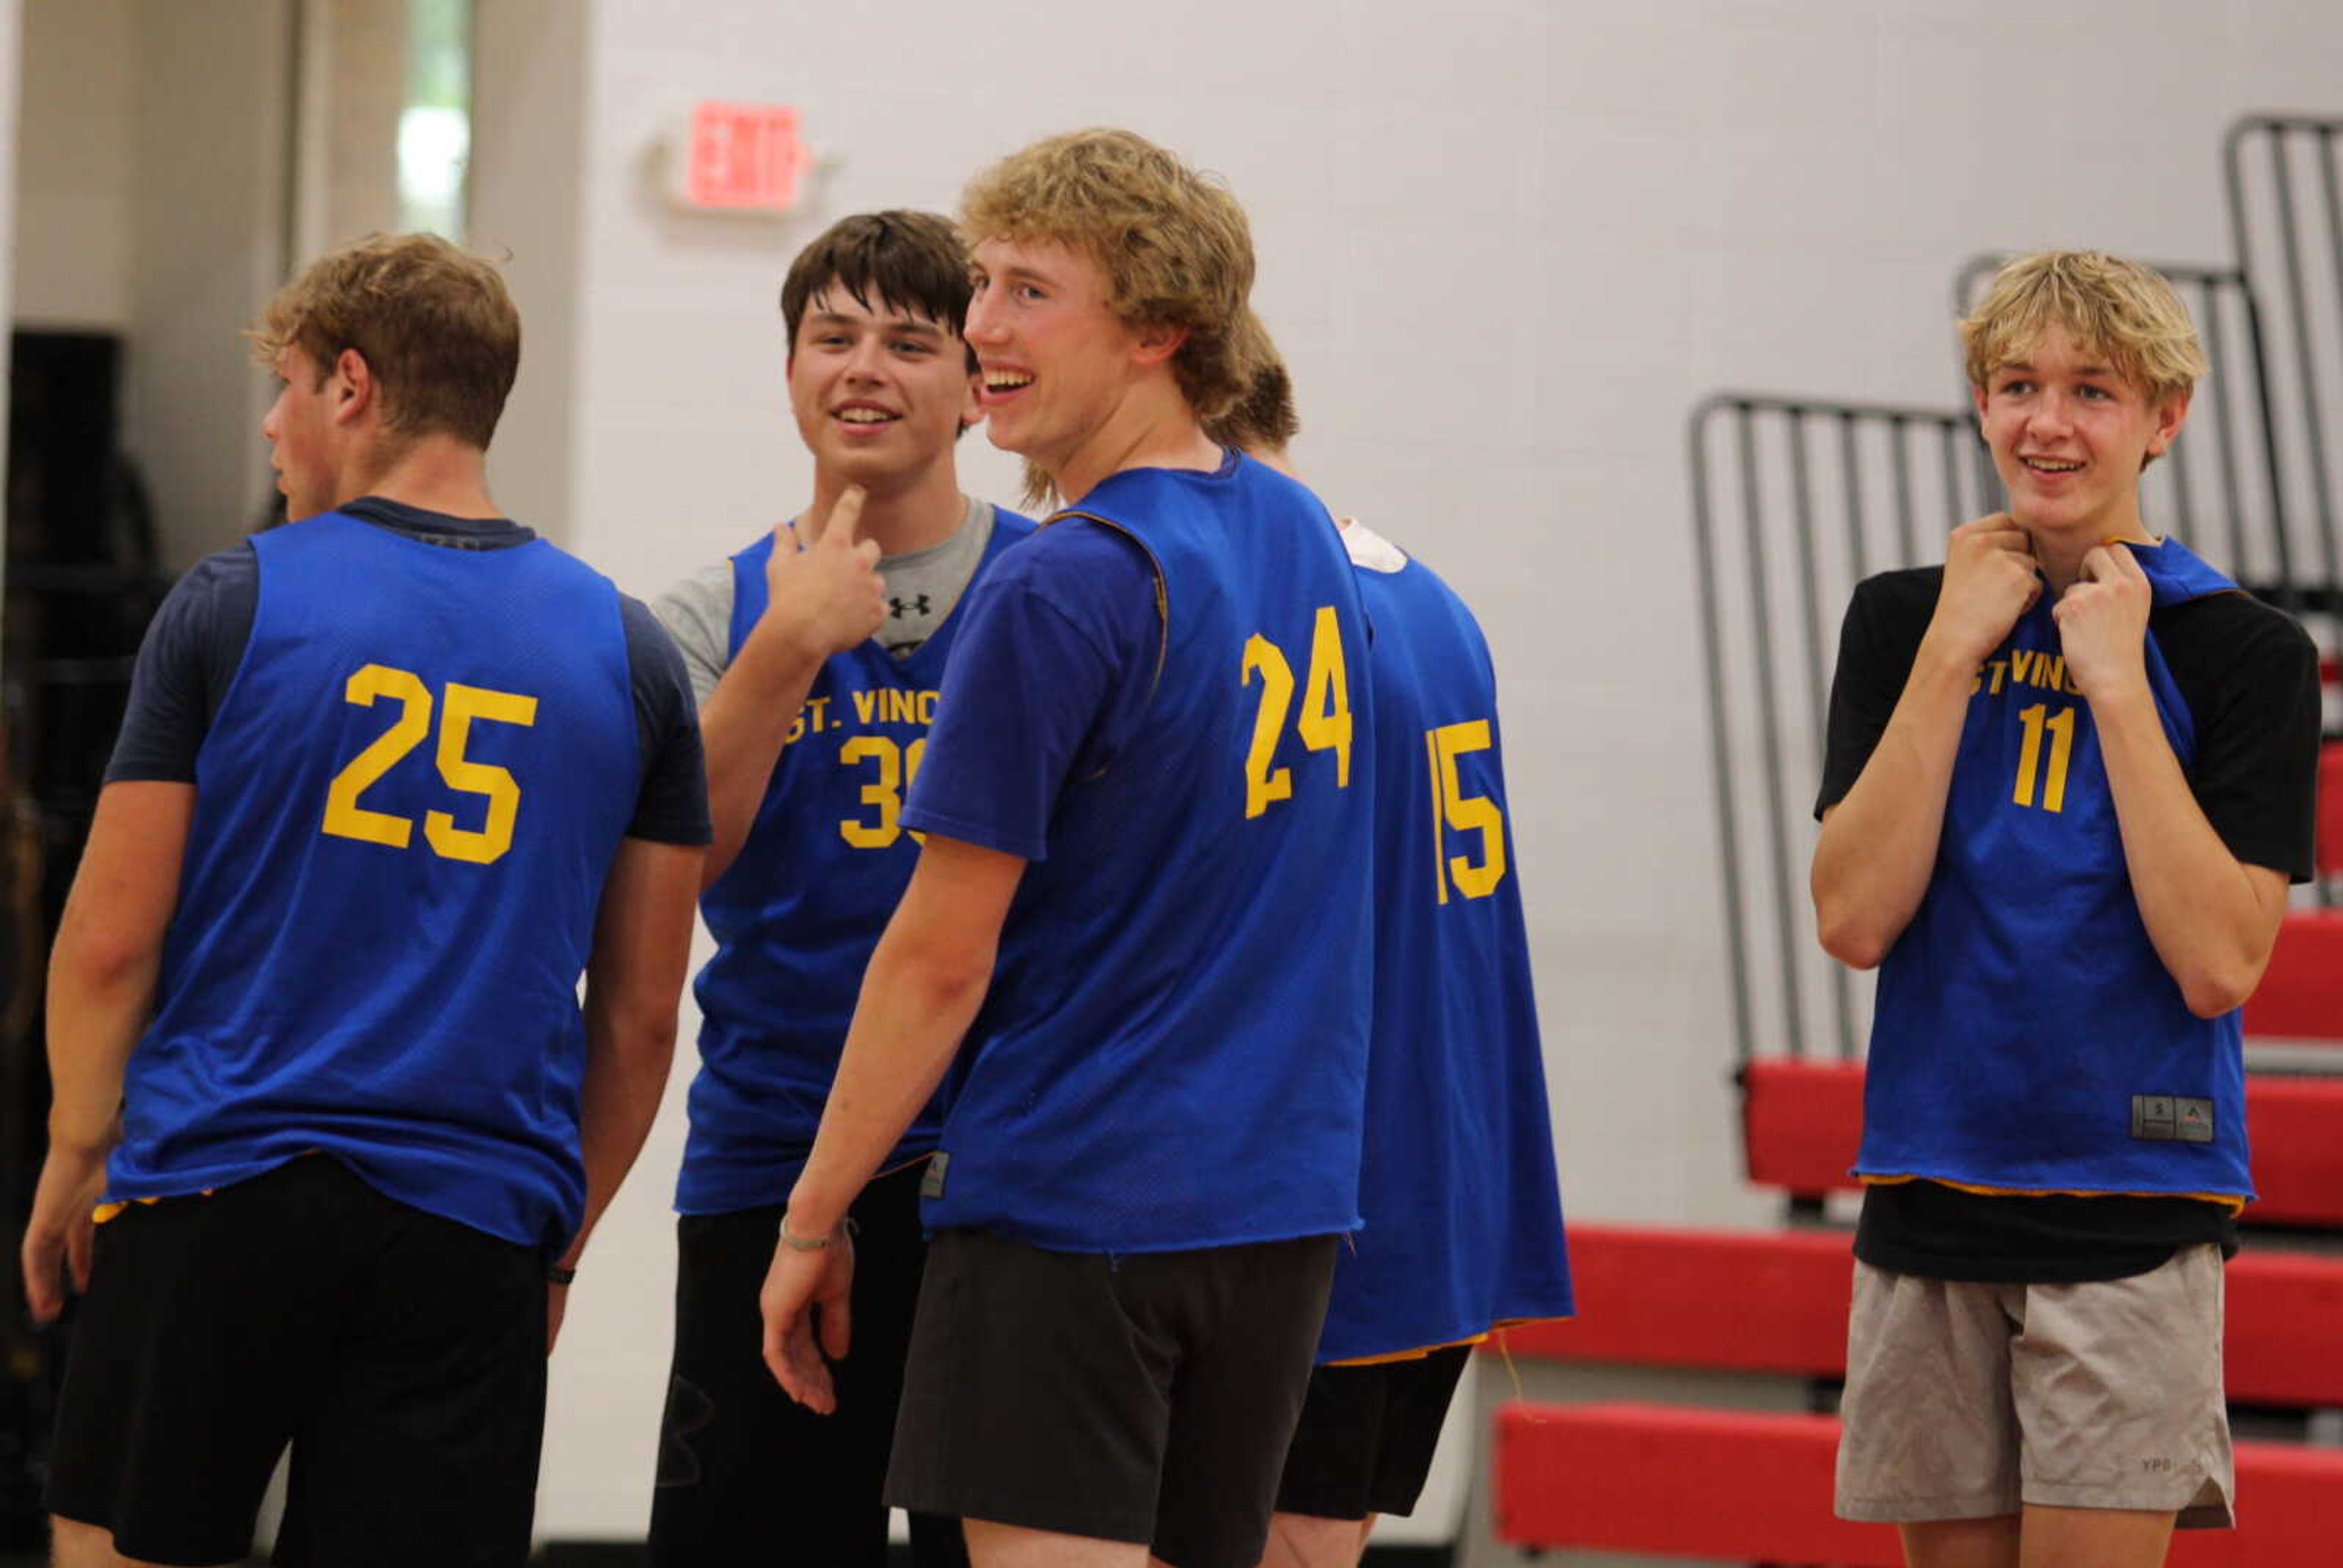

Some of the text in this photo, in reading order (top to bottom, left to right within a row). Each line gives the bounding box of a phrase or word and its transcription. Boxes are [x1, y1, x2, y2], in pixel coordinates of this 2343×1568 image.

[694, 104, 797, 200] EXIT
[323, 664, 538, 864] 25
[1242, 606, 1352, 819] 24
[2013, 702, 2075, 813] 11
[1426, 719, 1507, 904] 15
